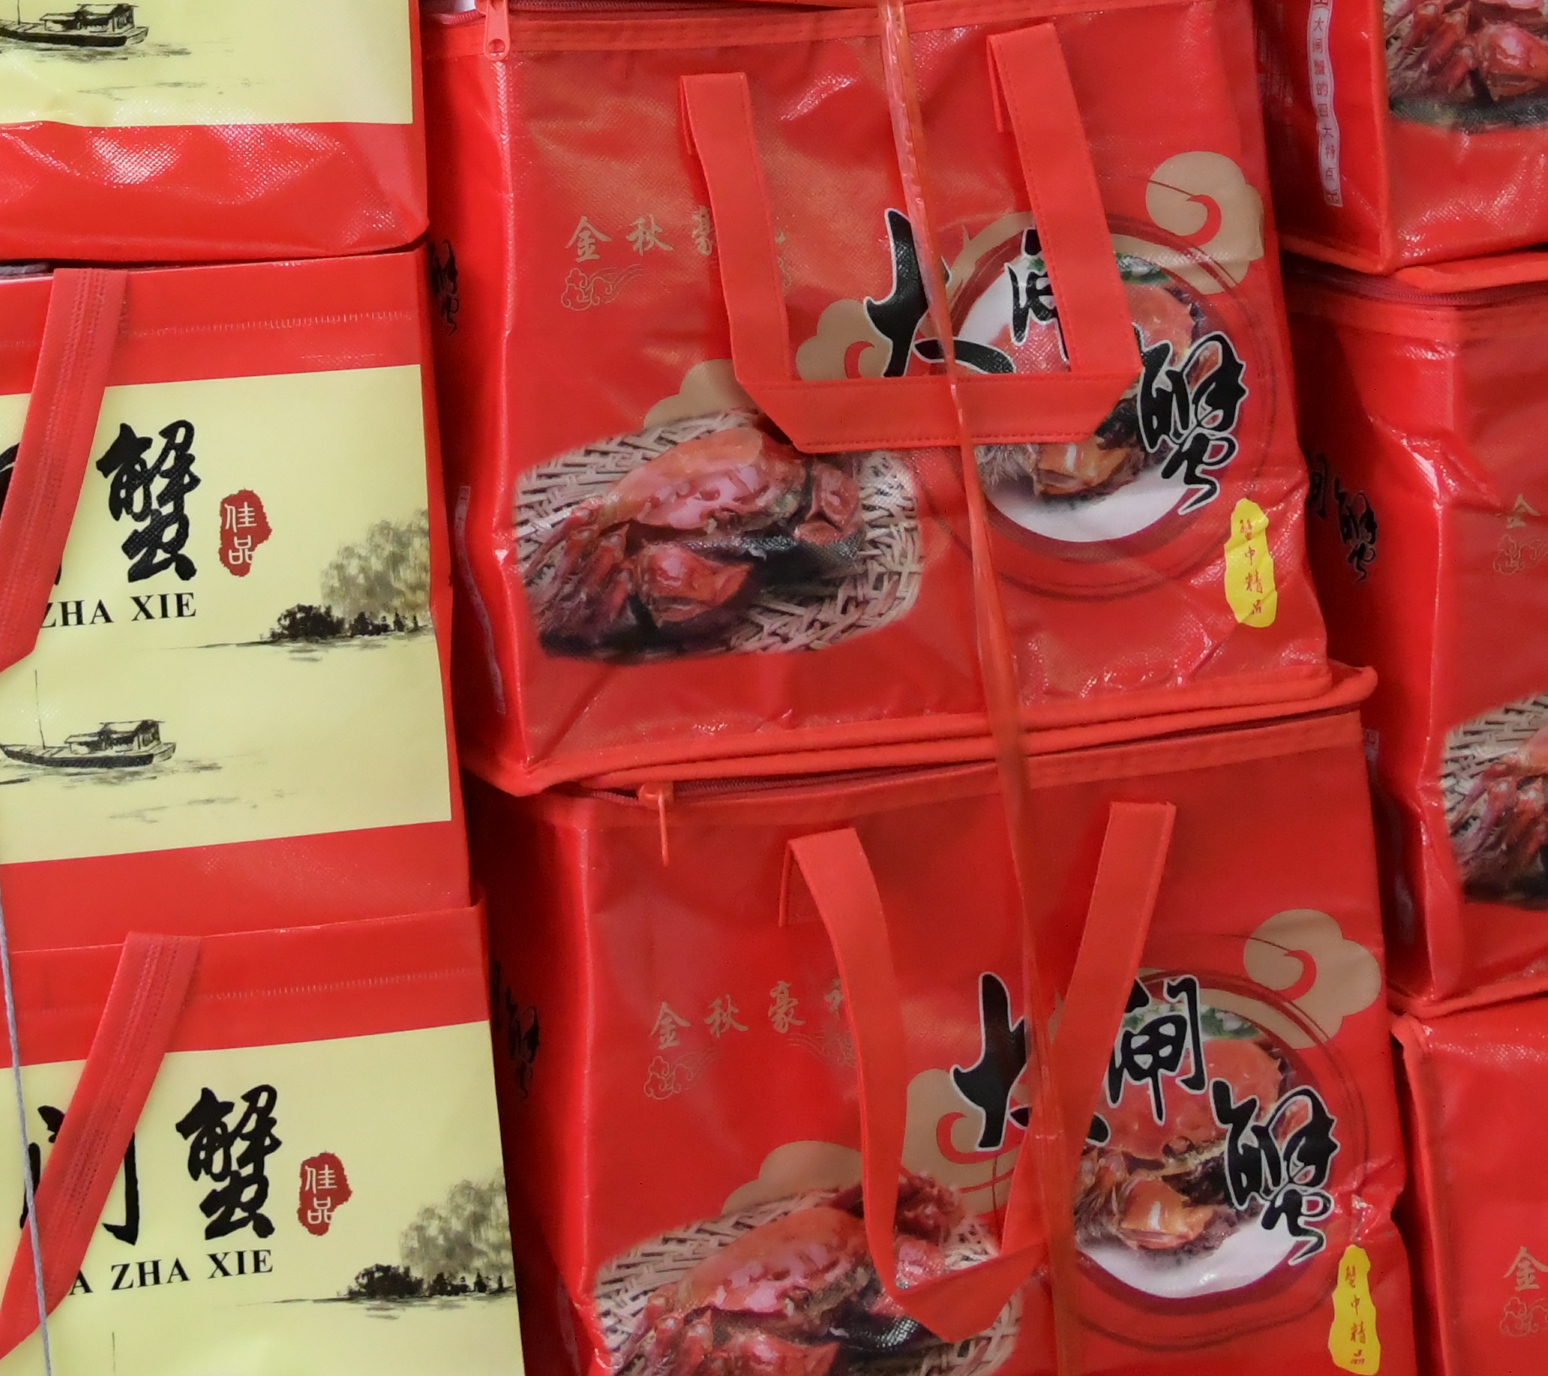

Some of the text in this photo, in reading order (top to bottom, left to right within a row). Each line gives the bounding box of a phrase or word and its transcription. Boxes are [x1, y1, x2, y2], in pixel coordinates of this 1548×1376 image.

[225, 501, 259, 567] 佳品
[132, 592, 197, 620] XIE
[304, 1165, 337, 1226] 佳品
[111, 1250, 275, 1291] ZHA XIE
